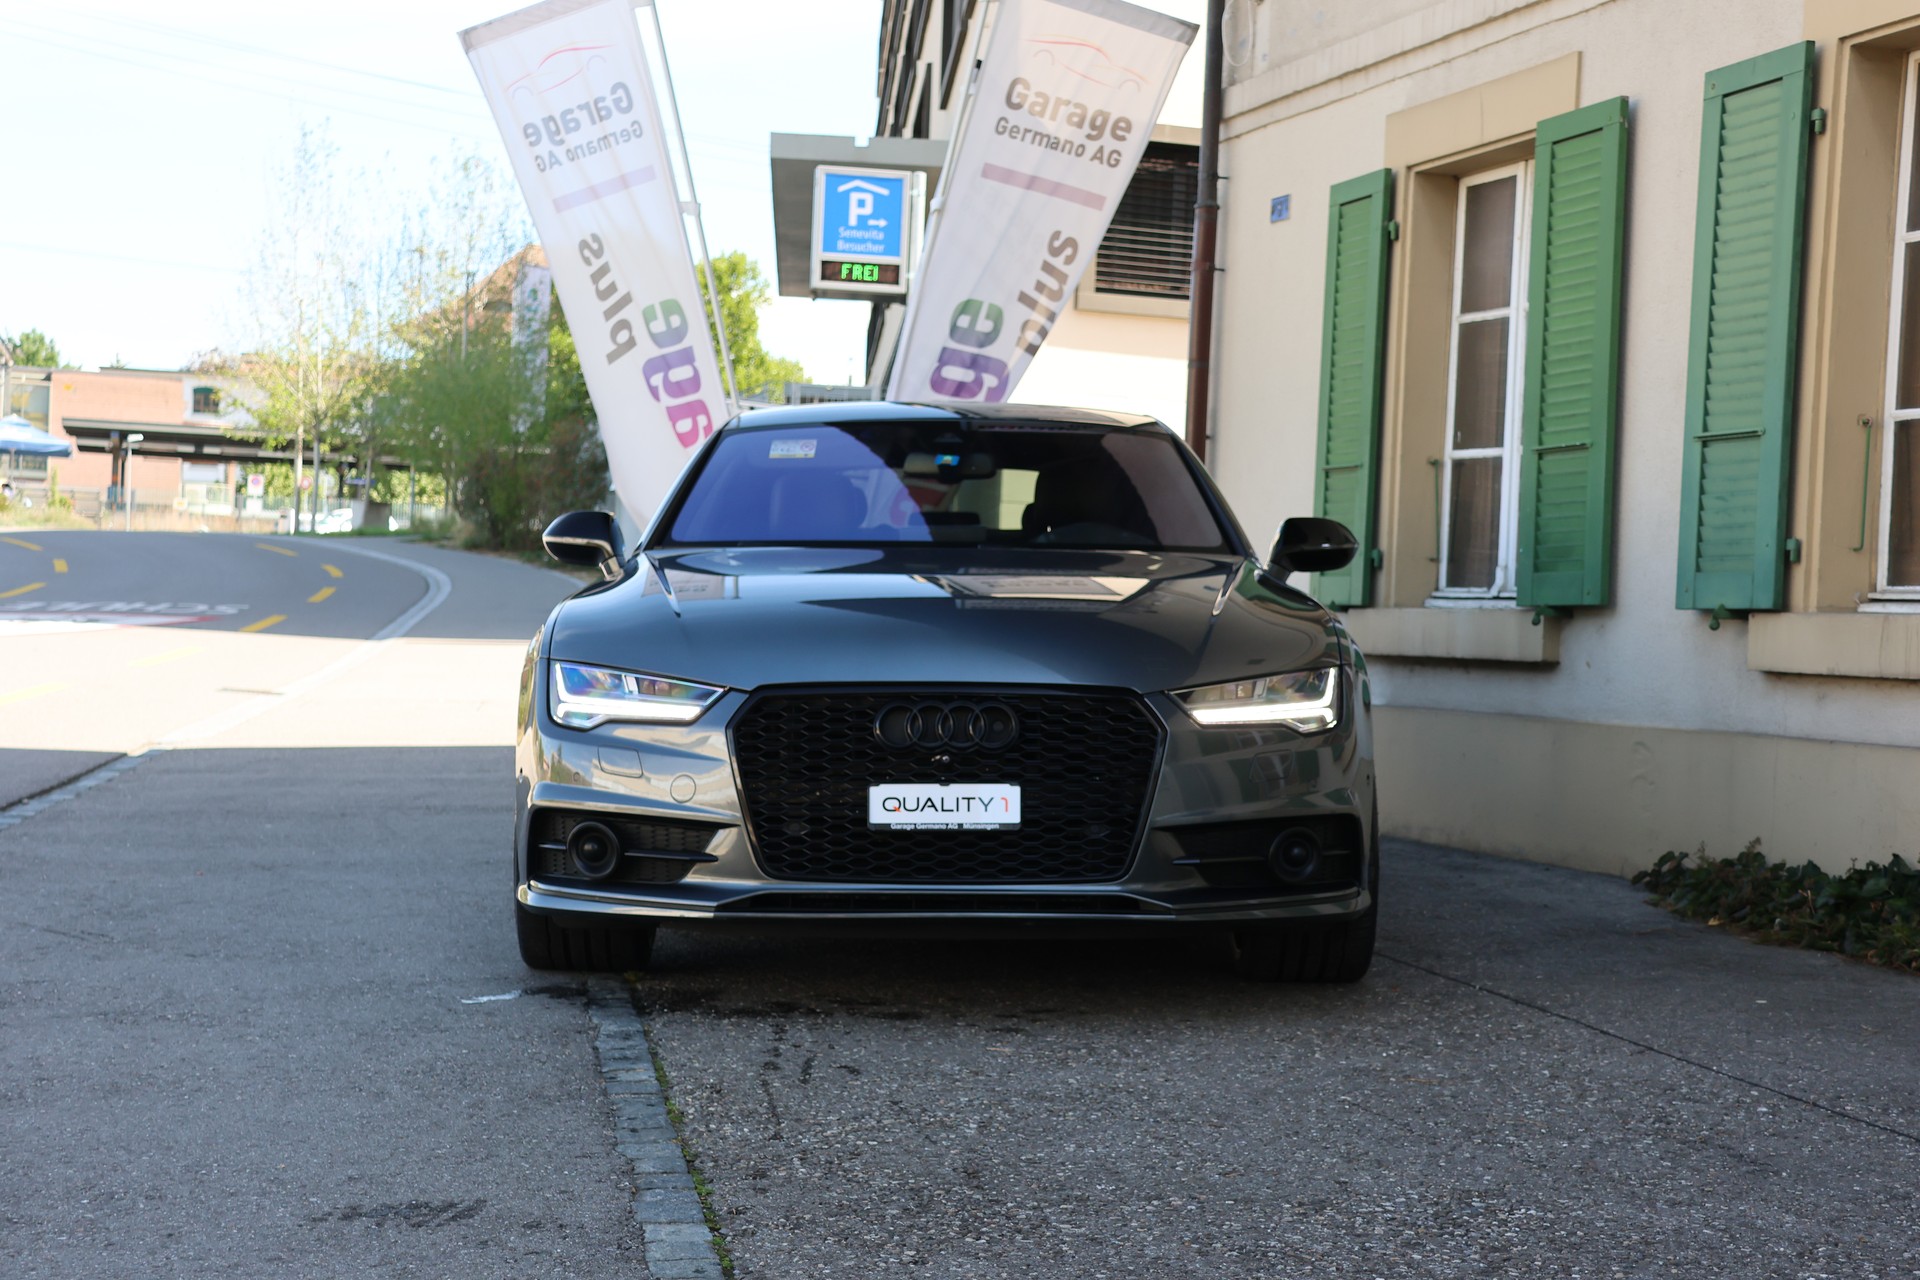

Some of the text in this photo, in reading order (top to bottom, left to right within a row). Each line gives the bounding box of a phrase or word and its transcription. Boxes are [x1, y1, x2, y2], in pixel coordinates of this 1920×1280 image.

[1005, 77, 1132, 142] Garage
[995, 117, 1122, 169] Germano AG
[848, 192, 874, 227] P
[837, 240, 885, 253] Besucher
[841, 263, 879, 281] FREI
[1015, 230, 1079, 357] plus
